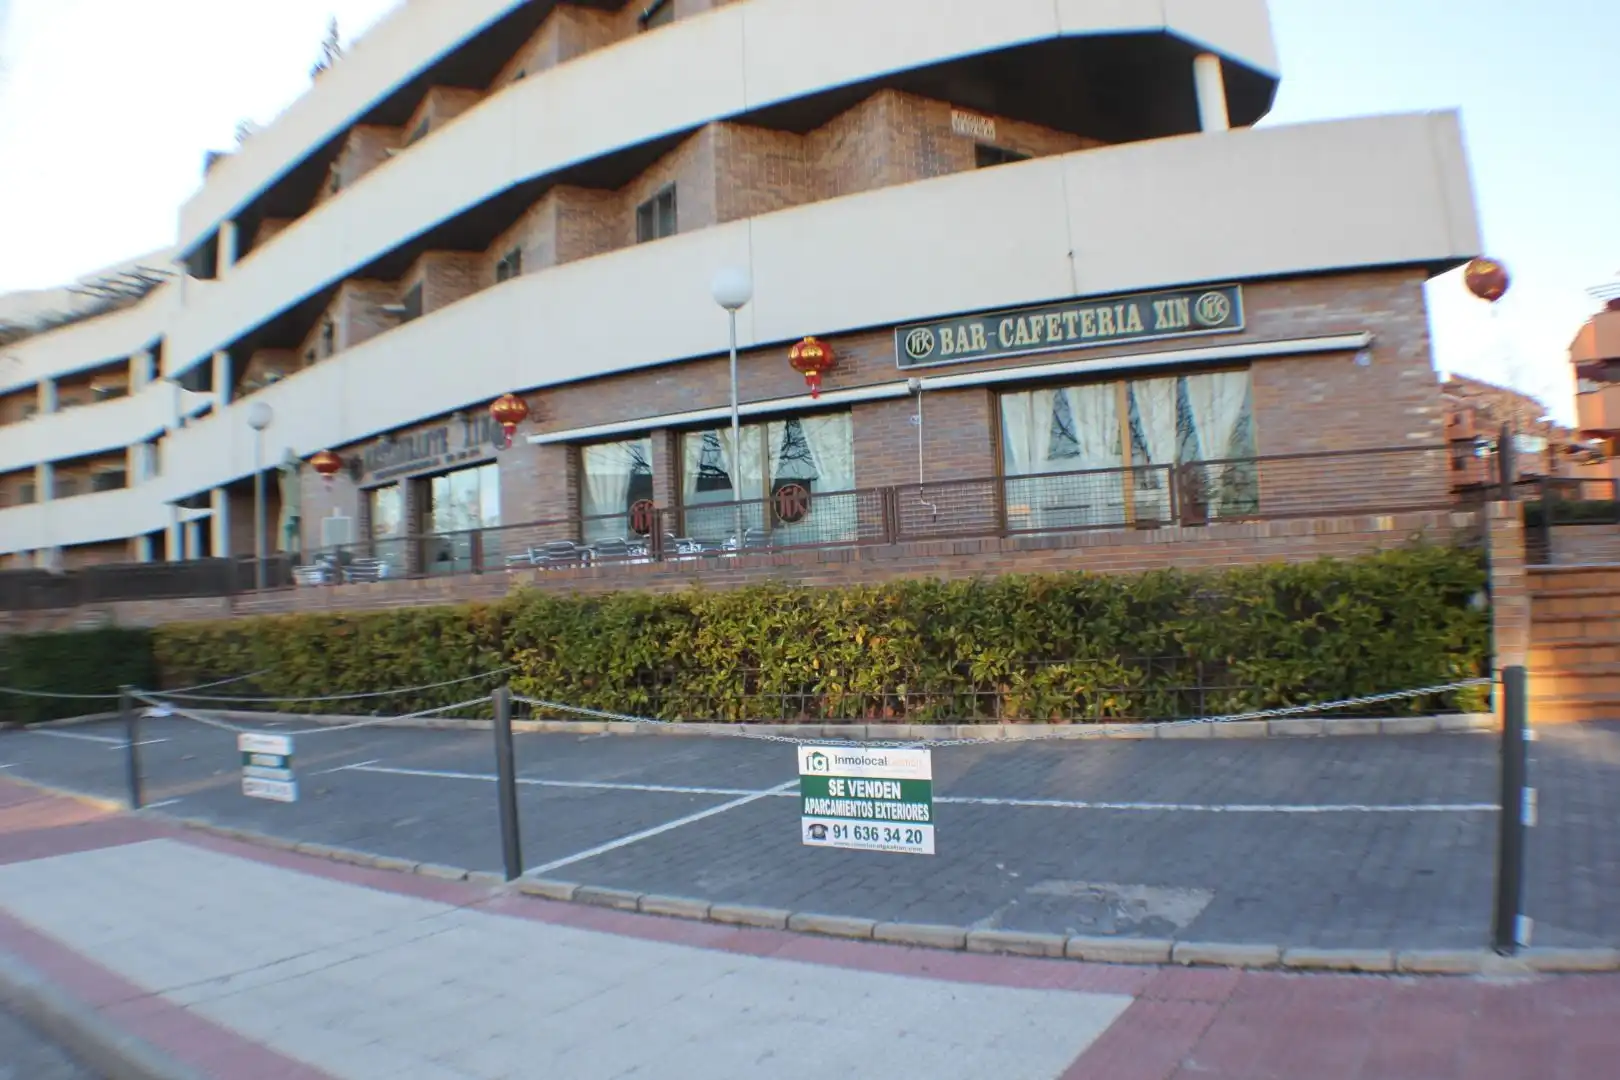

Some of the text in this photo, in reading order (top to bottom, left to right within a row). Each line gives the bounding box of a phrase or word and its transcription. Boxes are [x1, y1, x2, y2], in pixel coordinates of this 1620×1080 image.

[1152, 297, 1190, 330] XIN
[834, 754, 888, 767] Inmolocal
[828, 778, 902, 800] SE VENDEN
[804, 797, 929, 822] APARCAMIENTOS EXTERIORES
[833, 823, 923, 845] 91 636 34 20
